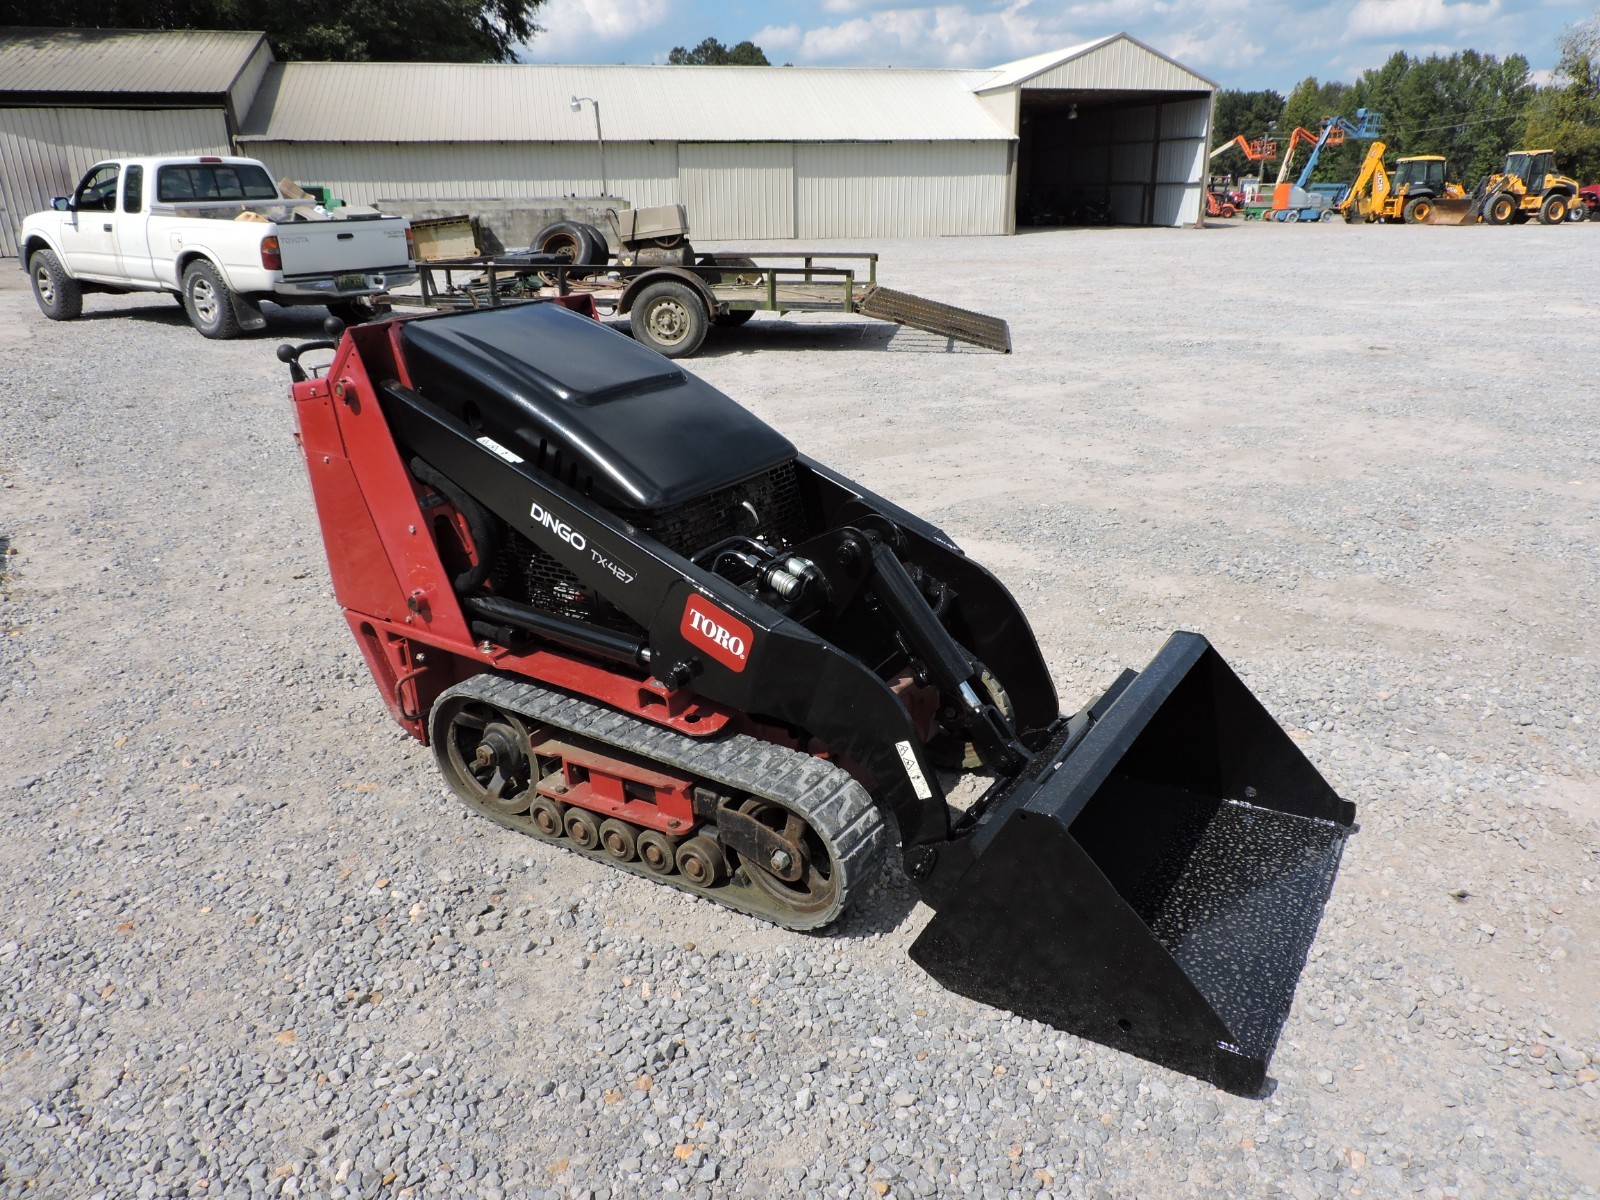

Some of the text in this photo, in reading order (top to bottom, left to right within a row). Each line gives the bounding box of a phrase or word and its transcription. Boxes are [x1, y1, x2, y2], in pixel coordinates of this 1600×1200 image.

[280, 236, 310, 244] TOYOTA
[530, 502, 586, 551] DINGO
[689, 608, 745, 656] TORO
